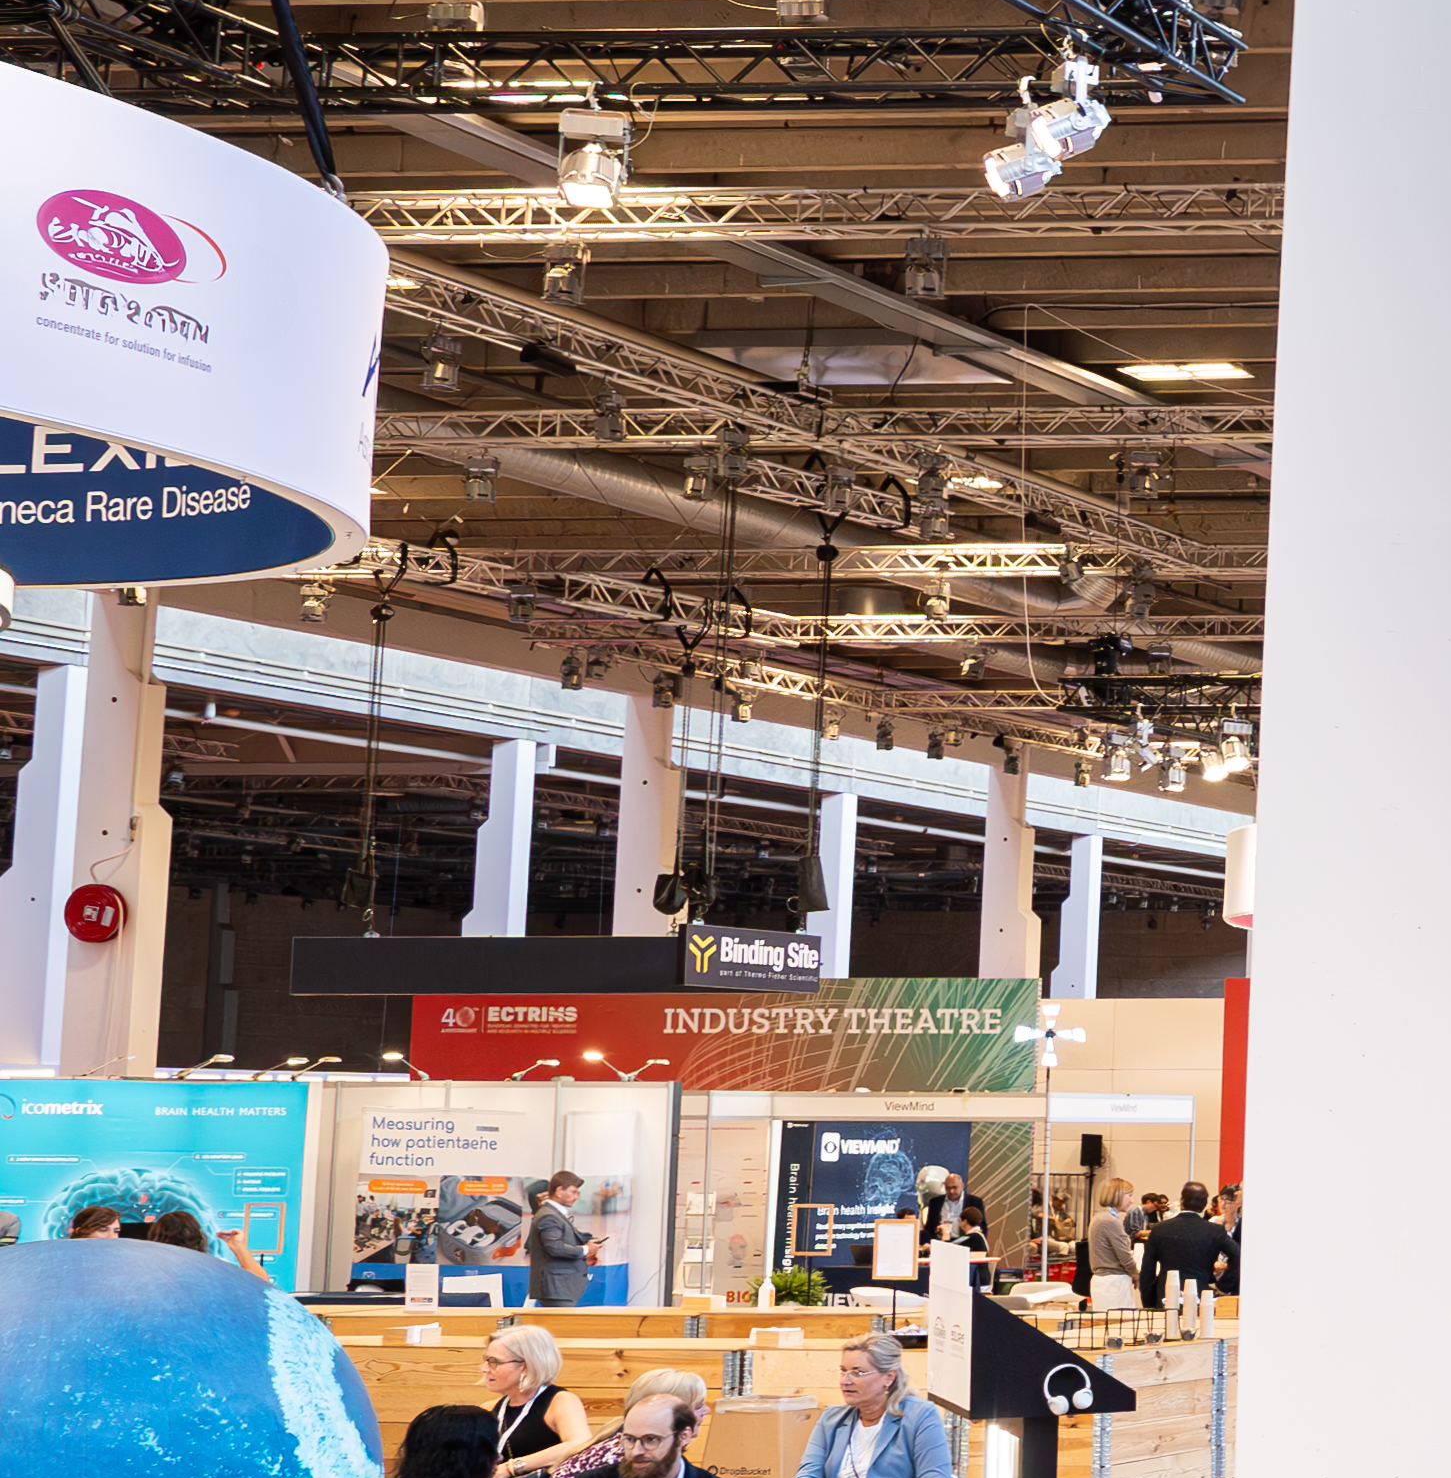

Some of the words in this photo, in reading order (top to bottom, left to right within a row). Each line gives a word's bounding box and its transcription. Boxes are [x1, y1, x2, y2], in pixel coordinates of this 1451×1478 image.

[36, 315, 102, 342] concentrate
[104, 331, 120, 347] for
[121, 338, 161, 359] solution
[163, 347, 176, 362] for
[86, 490, 153, 522] Rare
[162, 485, 251, 519] Disease
[720, 936, 786, 972] Binding
[787, 942, 819, 969] Site
[487, 1006, 578, 1022] ECTRIMS
[663, 1008, 834, 1035] INDUSTRY
[843, 1008, 1003, 1035] THEATRE
[22, 1099, 103, 1116] icometrix
[155, 1106, 187, 1117] BRAIN
[192, 1106, 234, 1117] HEALTH
[239, 1106, 287, 1117] MATTERS
[884, 1101, 935, 1112] ViewMind
[372, 1116, 455, 1134] Measuring
[371, 1134, 402, 1148] how
[369, 1152, 435, 1167] function
[789, 1163, 801, 1194] Brain
[719, 1466, 771, 1477] DropBucket
